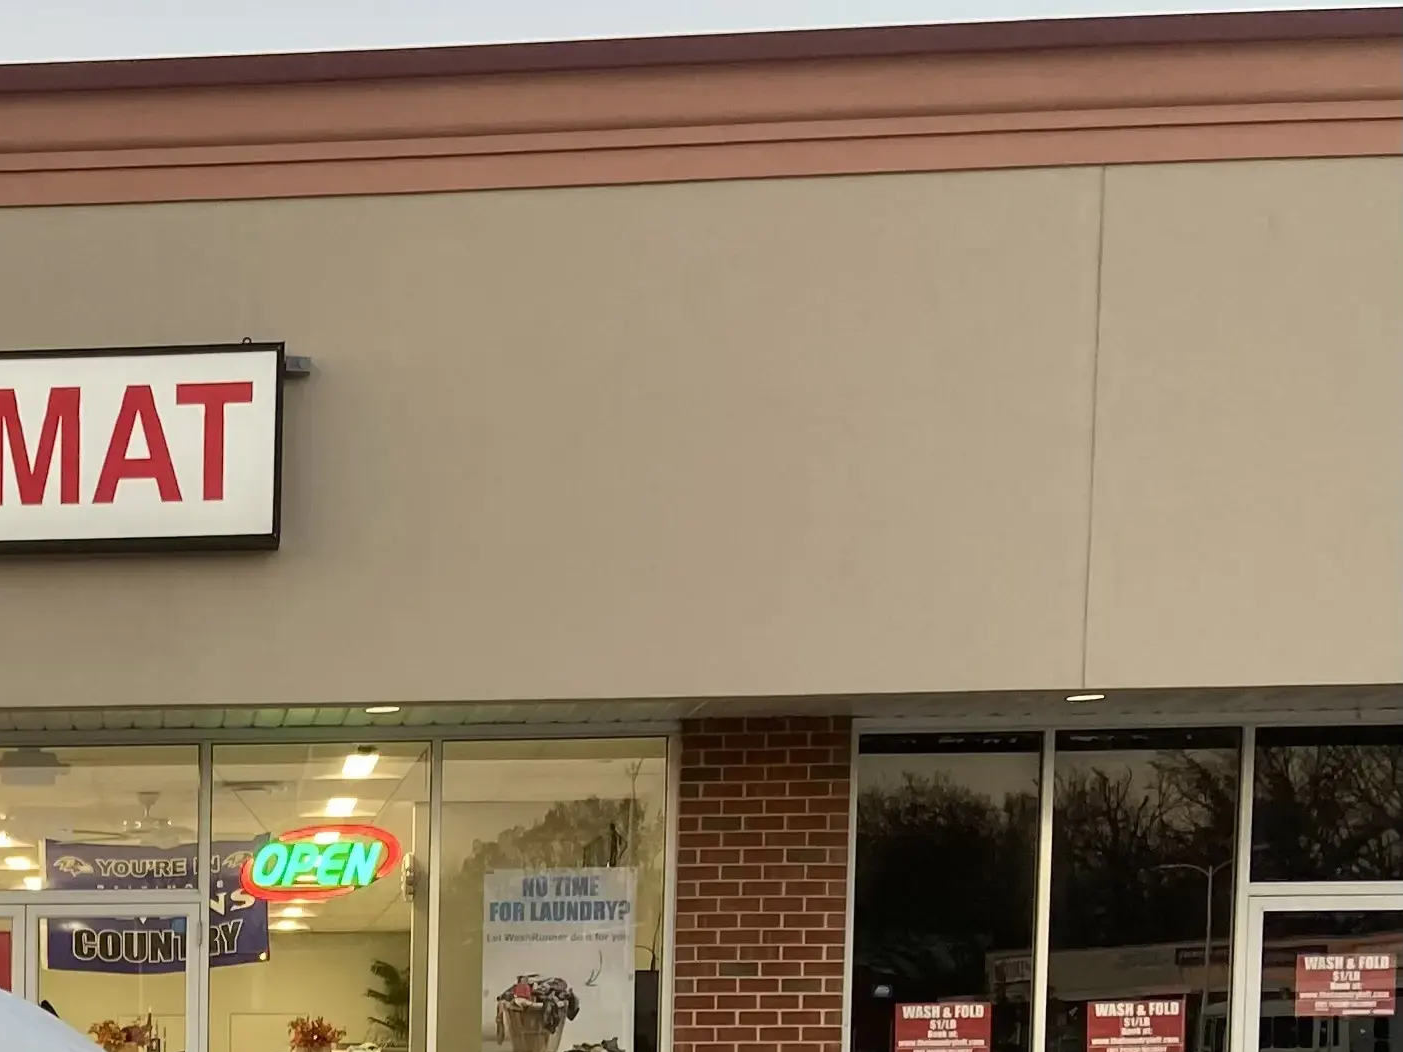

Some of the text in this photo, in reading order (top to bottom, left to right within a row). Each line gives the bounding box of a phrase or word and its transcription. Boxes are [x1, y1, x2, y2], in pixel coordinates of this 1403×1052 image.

[95, 858, 187, 877] YOU'RE
[252, 839, 383, 887] OPEN
[522, 876, 599, 897] NO TIME
[489, 900, 631, 922] FOR LAUNDRY?
[1304, 955, 1389, 970] WASH & FOLD
[902, 1004, 984, 1019] WASH & FOLD
[1095, 1001, 1179, 1017] WASH & FOLD
